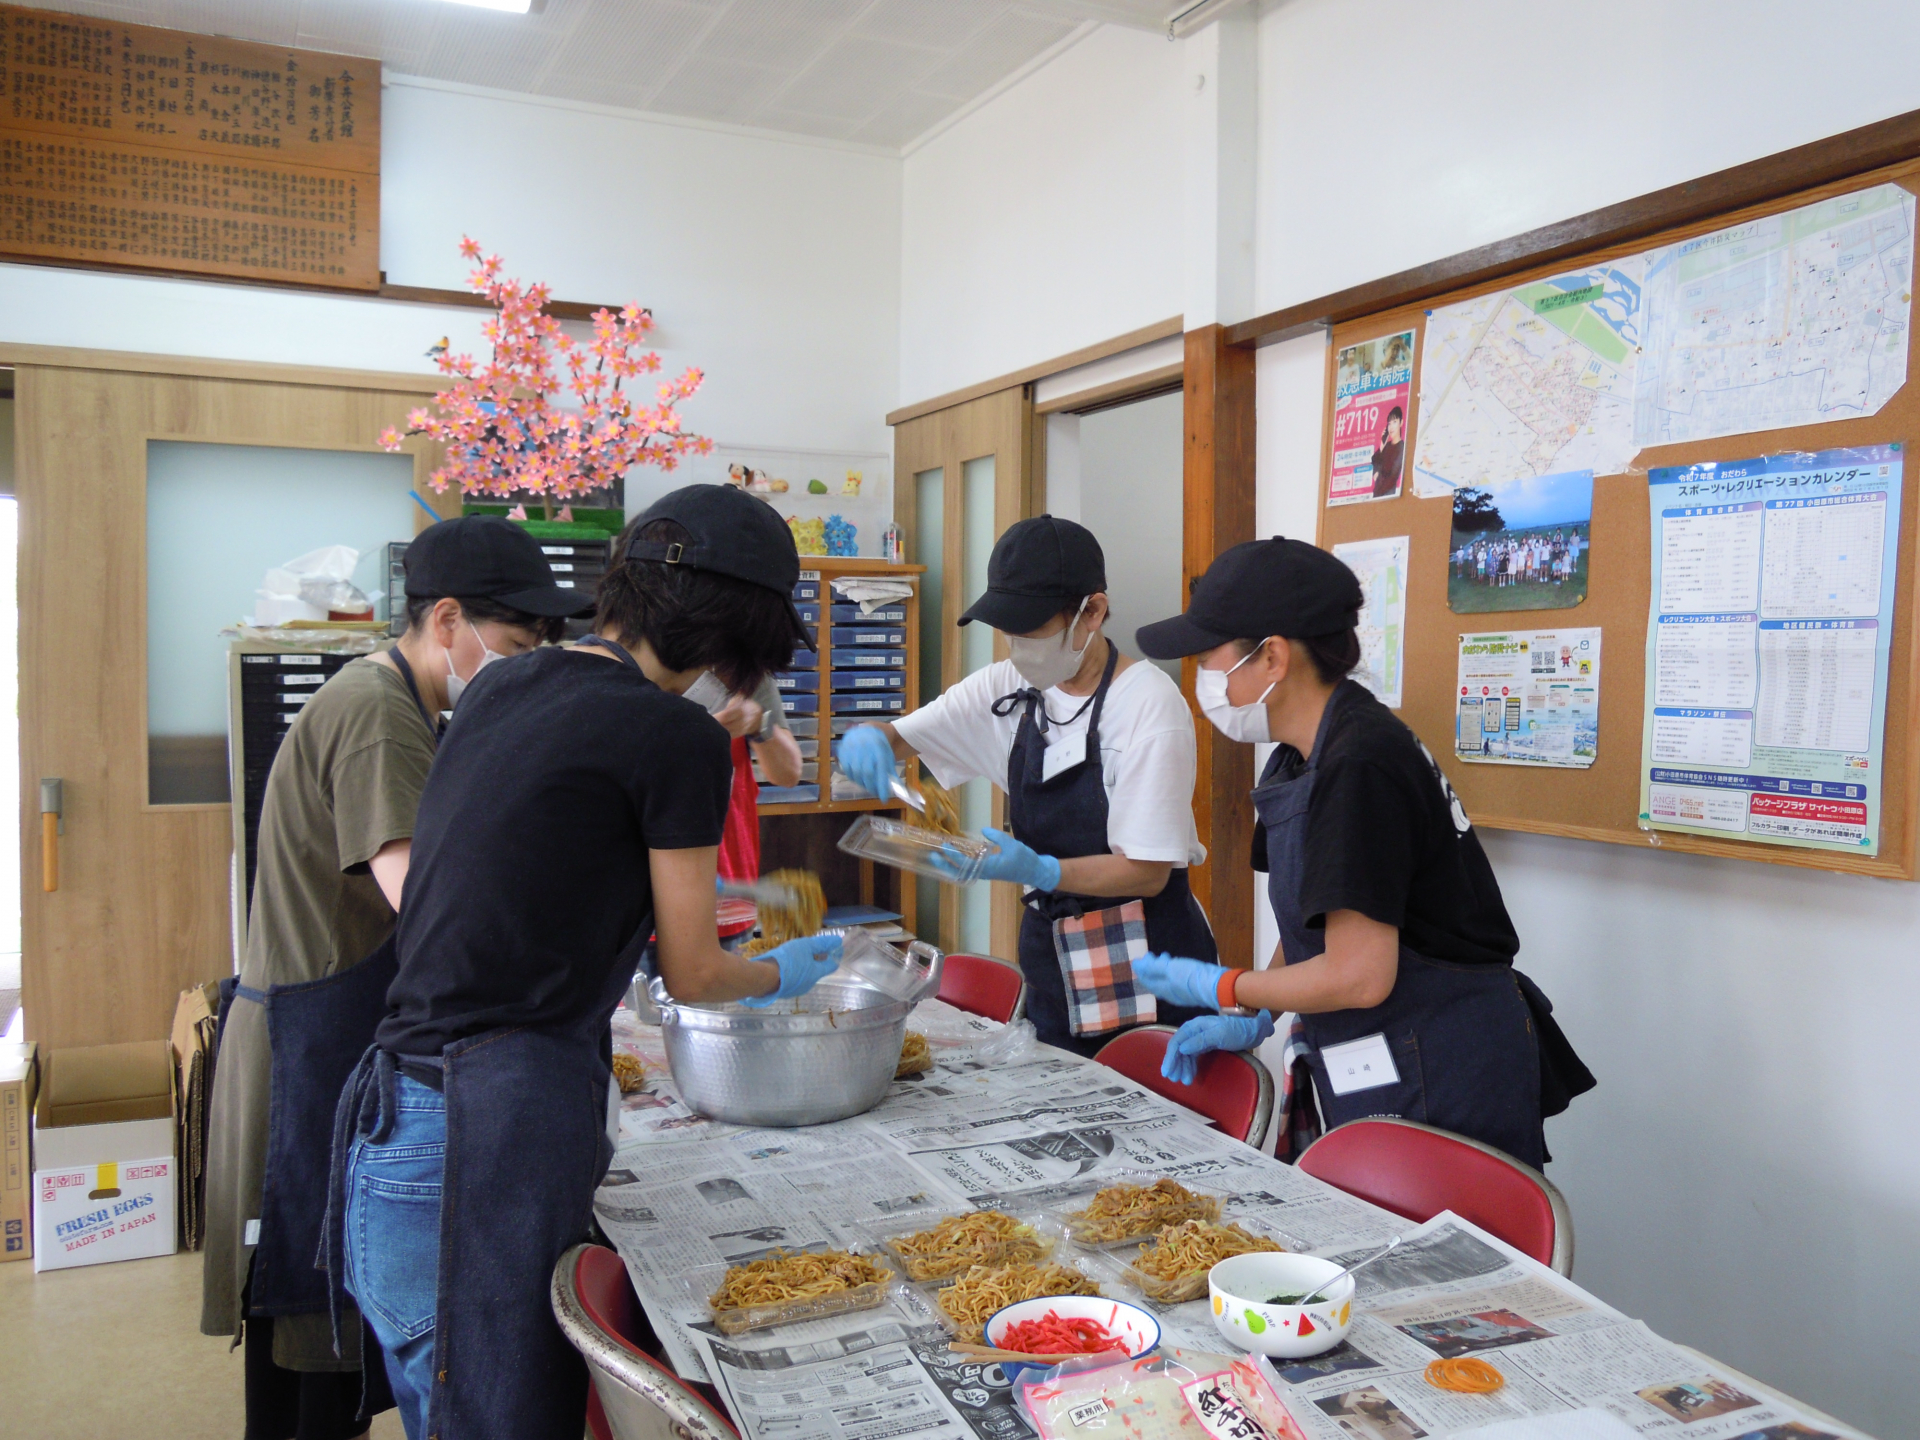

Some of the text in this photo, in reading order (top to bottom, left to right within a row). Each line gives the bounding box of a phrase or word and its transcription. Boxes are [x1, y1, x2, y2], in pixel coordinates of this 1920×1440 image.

[1335, 405, 1379, 438] #7119
[1678, 469, 1747, 483] 令和7年度 おだわら
[1678, 469, 1871, 497] スポーツ・レクリエーションカレンダー
[1652, 796, 1677, 806] ANGE
[1751, 797, 1808, 811] パッケージプラザ
[1751, 821, 1790, 832] フルカラー印刷
[55, 1207, 110, 1237] FRESH
[112, 1192, 154, 1217] EGGS
[65, 1233, 98, 1252] MADE
[102, 1227, 116, 1240] IN
[120, 1213, 157, 1233] JAPAN
[1261, 1310, 1276, 1328] PEAR
[1074, 1404, 1103, 1421] 業務用
